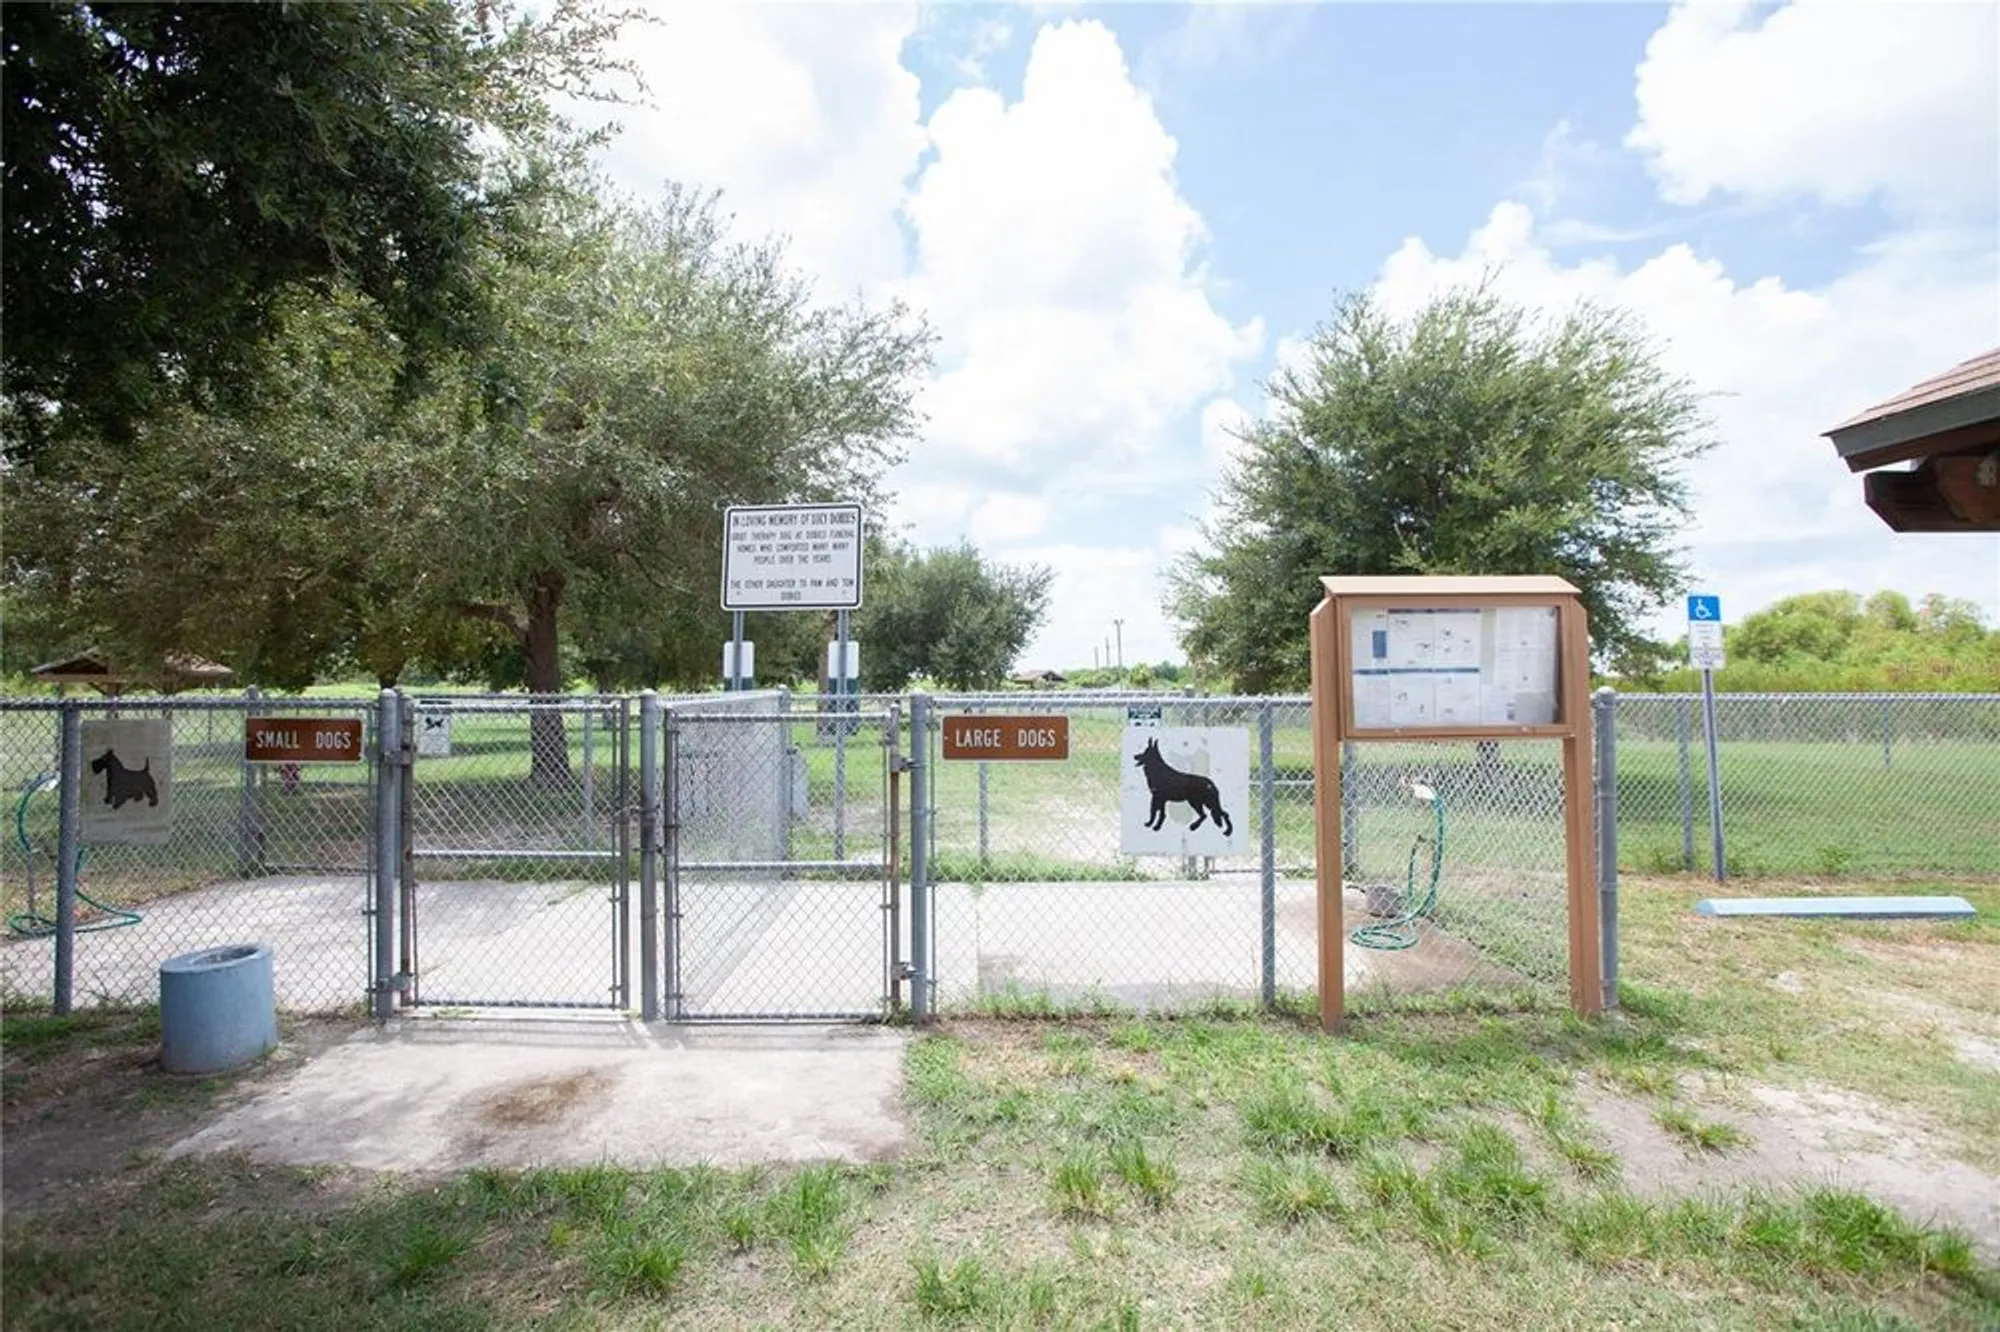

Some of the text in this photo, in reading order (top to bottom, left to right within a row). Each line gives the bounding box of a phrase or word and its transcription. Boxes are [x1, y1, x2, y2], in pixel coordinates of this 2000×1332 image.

[732, 516, 739, 527] IN
[741, 515, 767, 527] LOVING
[769, 514, 798, 526] MEMORY
[800, 513, 809, 525] OF
[752, 531, 776, 540] THERAPY
[780, 530, 792, 540] DOG
[795, 530, 803, 539] AT
[830, 529, 854, 538] FUNERAL
[760, 544, 772, 552] WHO
[812, 542, 828, 550] MANY
[832, 542, 849, 550] MANY
[753, 554, 832, 565] PEOPLE OVER THE YEARS
[731, 580, 741, 589] THE
[745, 579, 763, 589] OTHER
[766, 579, 796, 589] DAUGHTER
[800, 578, 807, 588] TO
[826, 578, 839, 588] AND
[255, 731, 352, 750] SMALL DOGS
[955, 728, 1057, 748] LARGE DOGS
